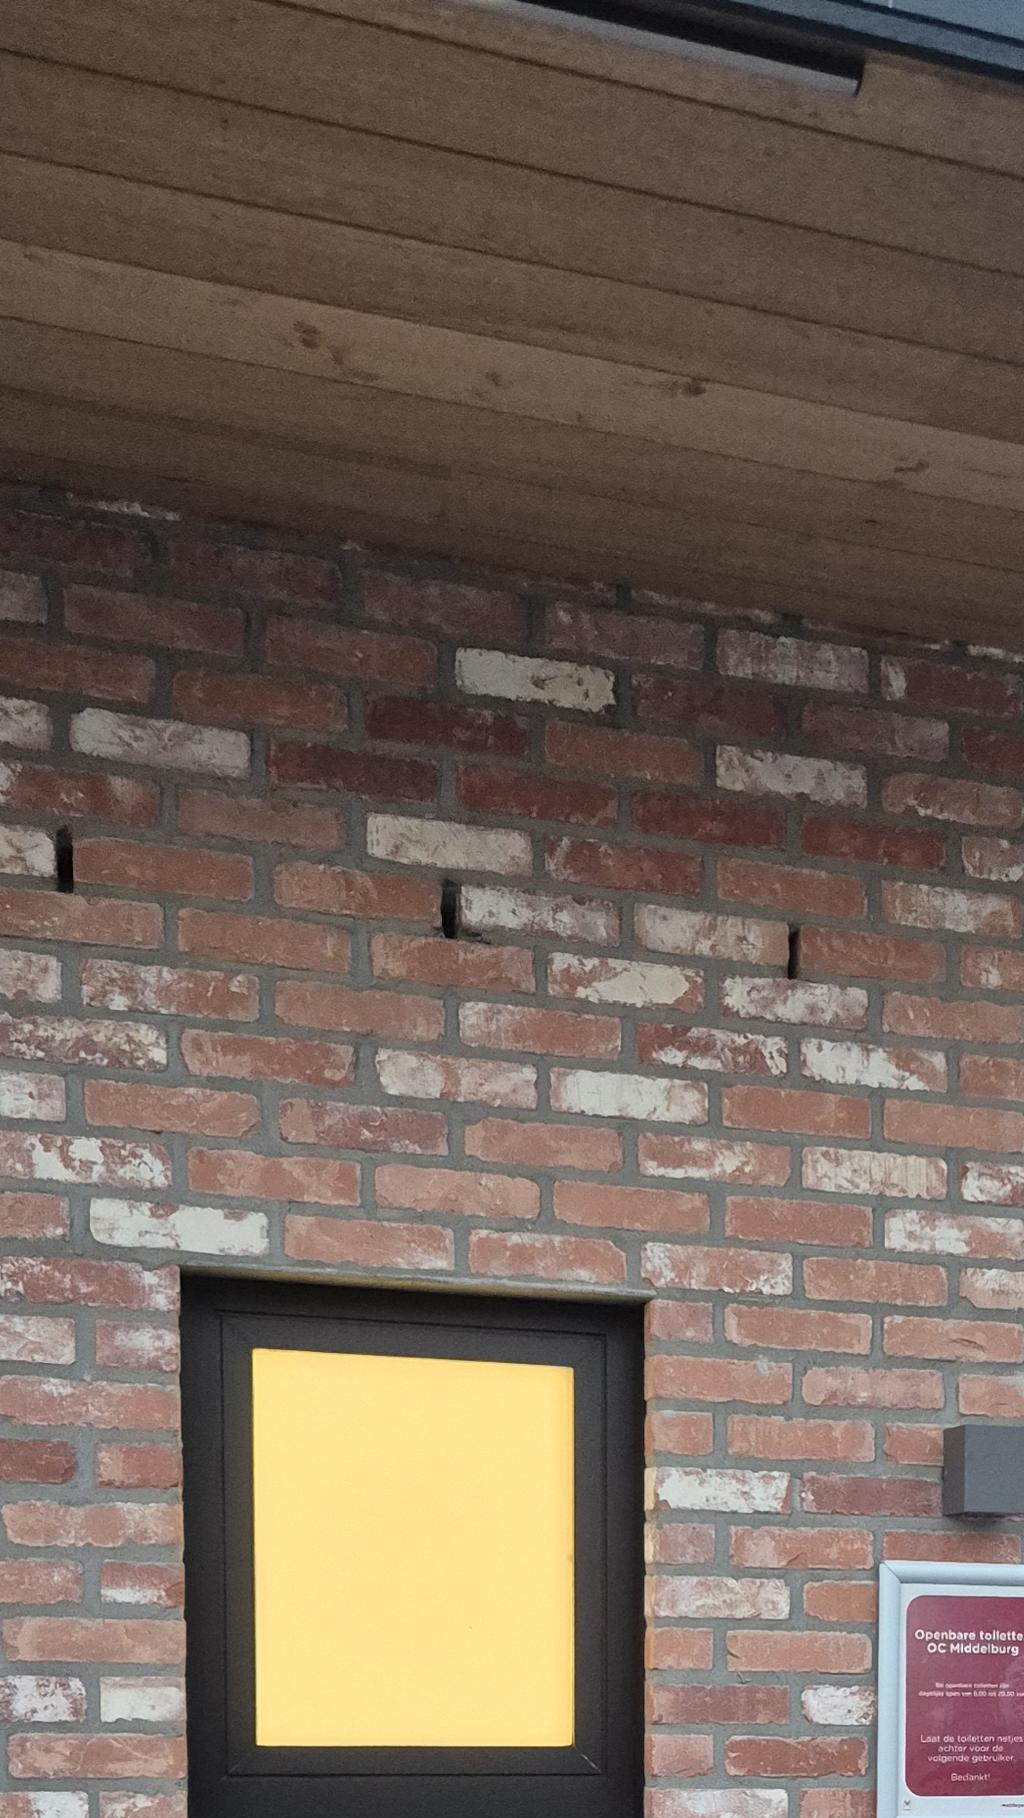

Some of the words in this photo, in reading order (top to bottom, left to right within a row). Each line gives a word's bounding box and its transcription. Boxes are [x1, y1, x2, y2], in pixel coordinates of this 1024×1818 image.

[914, 1629, 976, 1641] Openbare
[927, 1643, 946, 1653] OC
[950, 1643, 1019, 1656] Middelburg
[920, 1735, 940, 1743] Laat
[943, 1735, 955, 1743] de
[957, 1735, 994, 1743] toiletten
[997, 1735, 1023, 1744] netjes
[928, 1755, 969, 1763] volgende
[951, 1773, 991, 1781] Bedankt!
